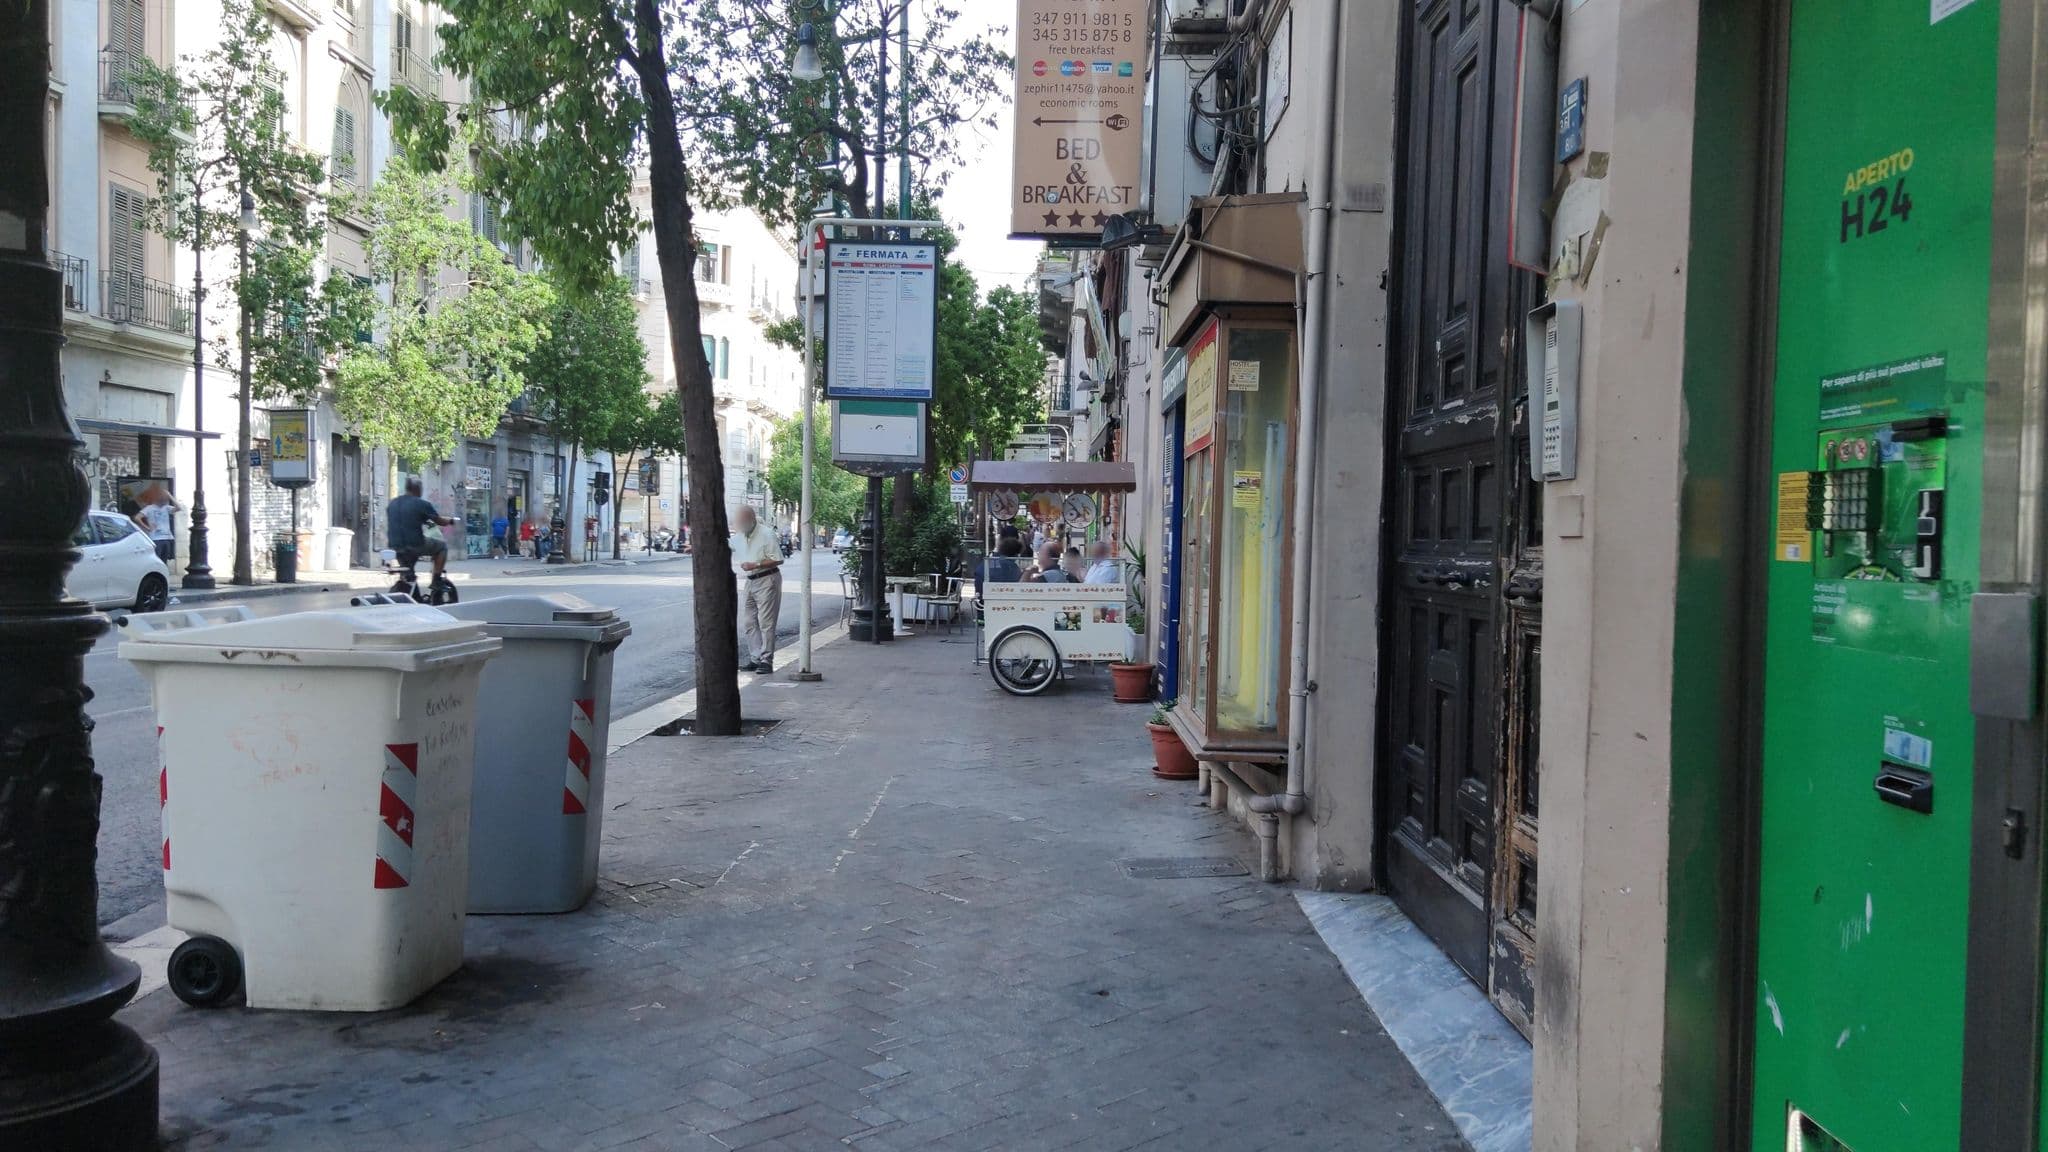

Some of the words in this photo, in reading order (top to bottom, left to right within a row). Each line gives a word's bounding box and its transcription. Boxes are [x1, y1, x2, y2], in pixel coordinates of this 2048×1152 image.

[1033, 12, 1058, 25] 347
[1063, 12, 1087, 25] 911
[1093, 13, 1117, 26] 981
[1124, 13, 1132, 26] 5
[1032, 28, 1058, 41] 345
[1063, 28, 1088, 41] 315
[1093, 29, 1118, 42] 875
[1123, 29, 1131, 42] 8
[1048, 45, 1067, 55] free
[1070, 45, 1115, 55] breakfast
[1040, 99, 1086, 108] economic
[1089, 99, 1118, 108] rooms
[1056, 138, 1100, 160] BED
[1066, 162, 1087, 185] &
[1843, 147, 1914, 196] APERTO
[1840, 176, 1912, 243] H24
[856, 250, 908, 259] FERMATA
[1821, 378, 1834, 389] Per
[1889, 360, 1921, 377] prodotti
